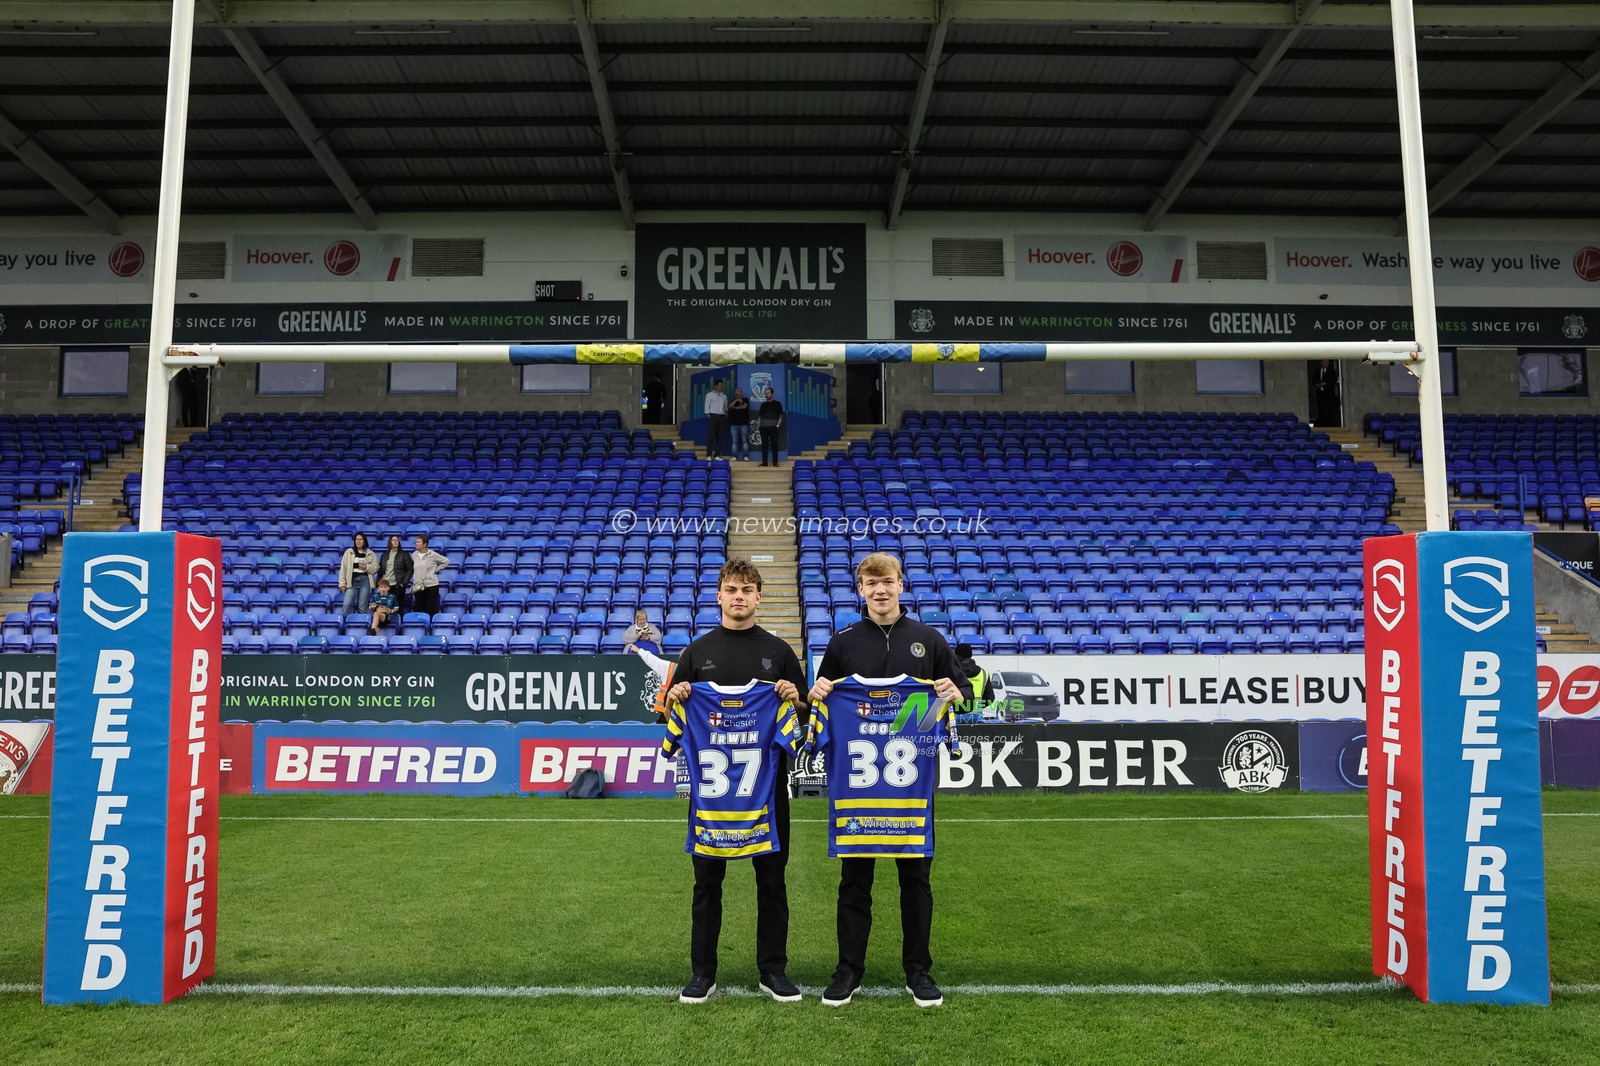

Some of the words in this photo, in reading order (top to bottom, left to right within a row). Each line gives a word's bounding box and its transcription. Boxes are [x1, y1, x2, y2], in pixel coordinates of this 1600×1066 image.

[25, 254, 63, 270] you
[65, 249, 96, 266] live
[247, 248, 313, 265] Hoover.
[1028, 248, 1096, 265] Hoover.
[1286, 251, 1352, 268] Hoover.
[1362, 252, 1408, 268] Wash
[1450, 256, 1485, 273] way
[1491, 256, 1524, 273] you
[1530, 254, 1561, 270] live
[656, 246, 845, 291] GREENALL'S
[535, 284, 556, 298] SHOT
[667, 299, 688, 307] THE
[690, 298, 739, 307] ORIGINAL
[742, 298, 787, 307] LONDON
[790, 298, 811, 307] DRY
[813, 299, 832, 307] GIN
[24, 319, 34, 329] A
[39, 318, 77, 329] DROP
[81, 318, 100, 329] OF
[104, 318, 182, 329] GREATS
[186, 317, 226, 328] SINCE
[231, 317, 257, 328] 1761
[278, 309, 367, 332] GREENALL'S
[384, 315, 425, 327] MADE
[430, 316, 445, 327] IN
[449, 315, 545, 326] WARRINGTON
[550, 315, 590, 326] SINCE
[595, 315, 622, 326] 1761
[725, 310, 754, 319] SINCE
[757, 310, 777, 318] 1761
[953, 316, 994, 327] MADE
[999, 316, 1014, 327] IN
[1018, 316, 1113, 327] WARRINGTON
[1118, 317, 1158, 328] SINCE
[1162, 317, 1188, 328] 1761
[1209, 311, 1296, 334] GREENALL'S
[1313, 320, 1323, 330] A
[1327, 320, 1364, 331] DROP
[1370, 320, 1387, 331] OF
[1391, 320, 1467, 331] GRENESS
[1472, 321, 1510, 332] SINCE
[1515, 321, 1541, 332] 1761
[0, 671, 57, 709] REE
[295, 675, 362, 687] LONDON
[371, 676, 402, 687] DRY
[407, 676, 435, 688] GIN
[465, 670, 626, 711] GREENALL'S
[1063, 678, 1164, 705] RENT
[1179, 677, 1290, 704] LEASE
[1304, 676, 1366, 704] BUY
[225, 695, 241, 707] IN
[246, 695, 351, 707] WARRINGTON
[357, 695, 402, 707] SINCE
[407, 696, 436, 707] 1761
[723, 719, 757, 728] Chester
[1248, 734, 1268, 742] YEARS
[275, 745, 497, 783] BETFRED
[847, 739, 919, 788] 38
[1036, 739, 1195, 788] BEER
[698, 748, 763, 798] 37
[1238, 770, 1271, 784] ABK
[80, 649, 136, 991] BETFRED
[181, 649, 209, 980] BETFRED
[1381, 649, 1409, 976] BETFRED
[1459, 651, 1511, 991] BETFRED
[862, 817, 917, 829] Wirehouse
[714, 827, 767, 841] Wirehouse
[716, 841, 738, 849] Employer
[739, 838, 757, 847] Services
